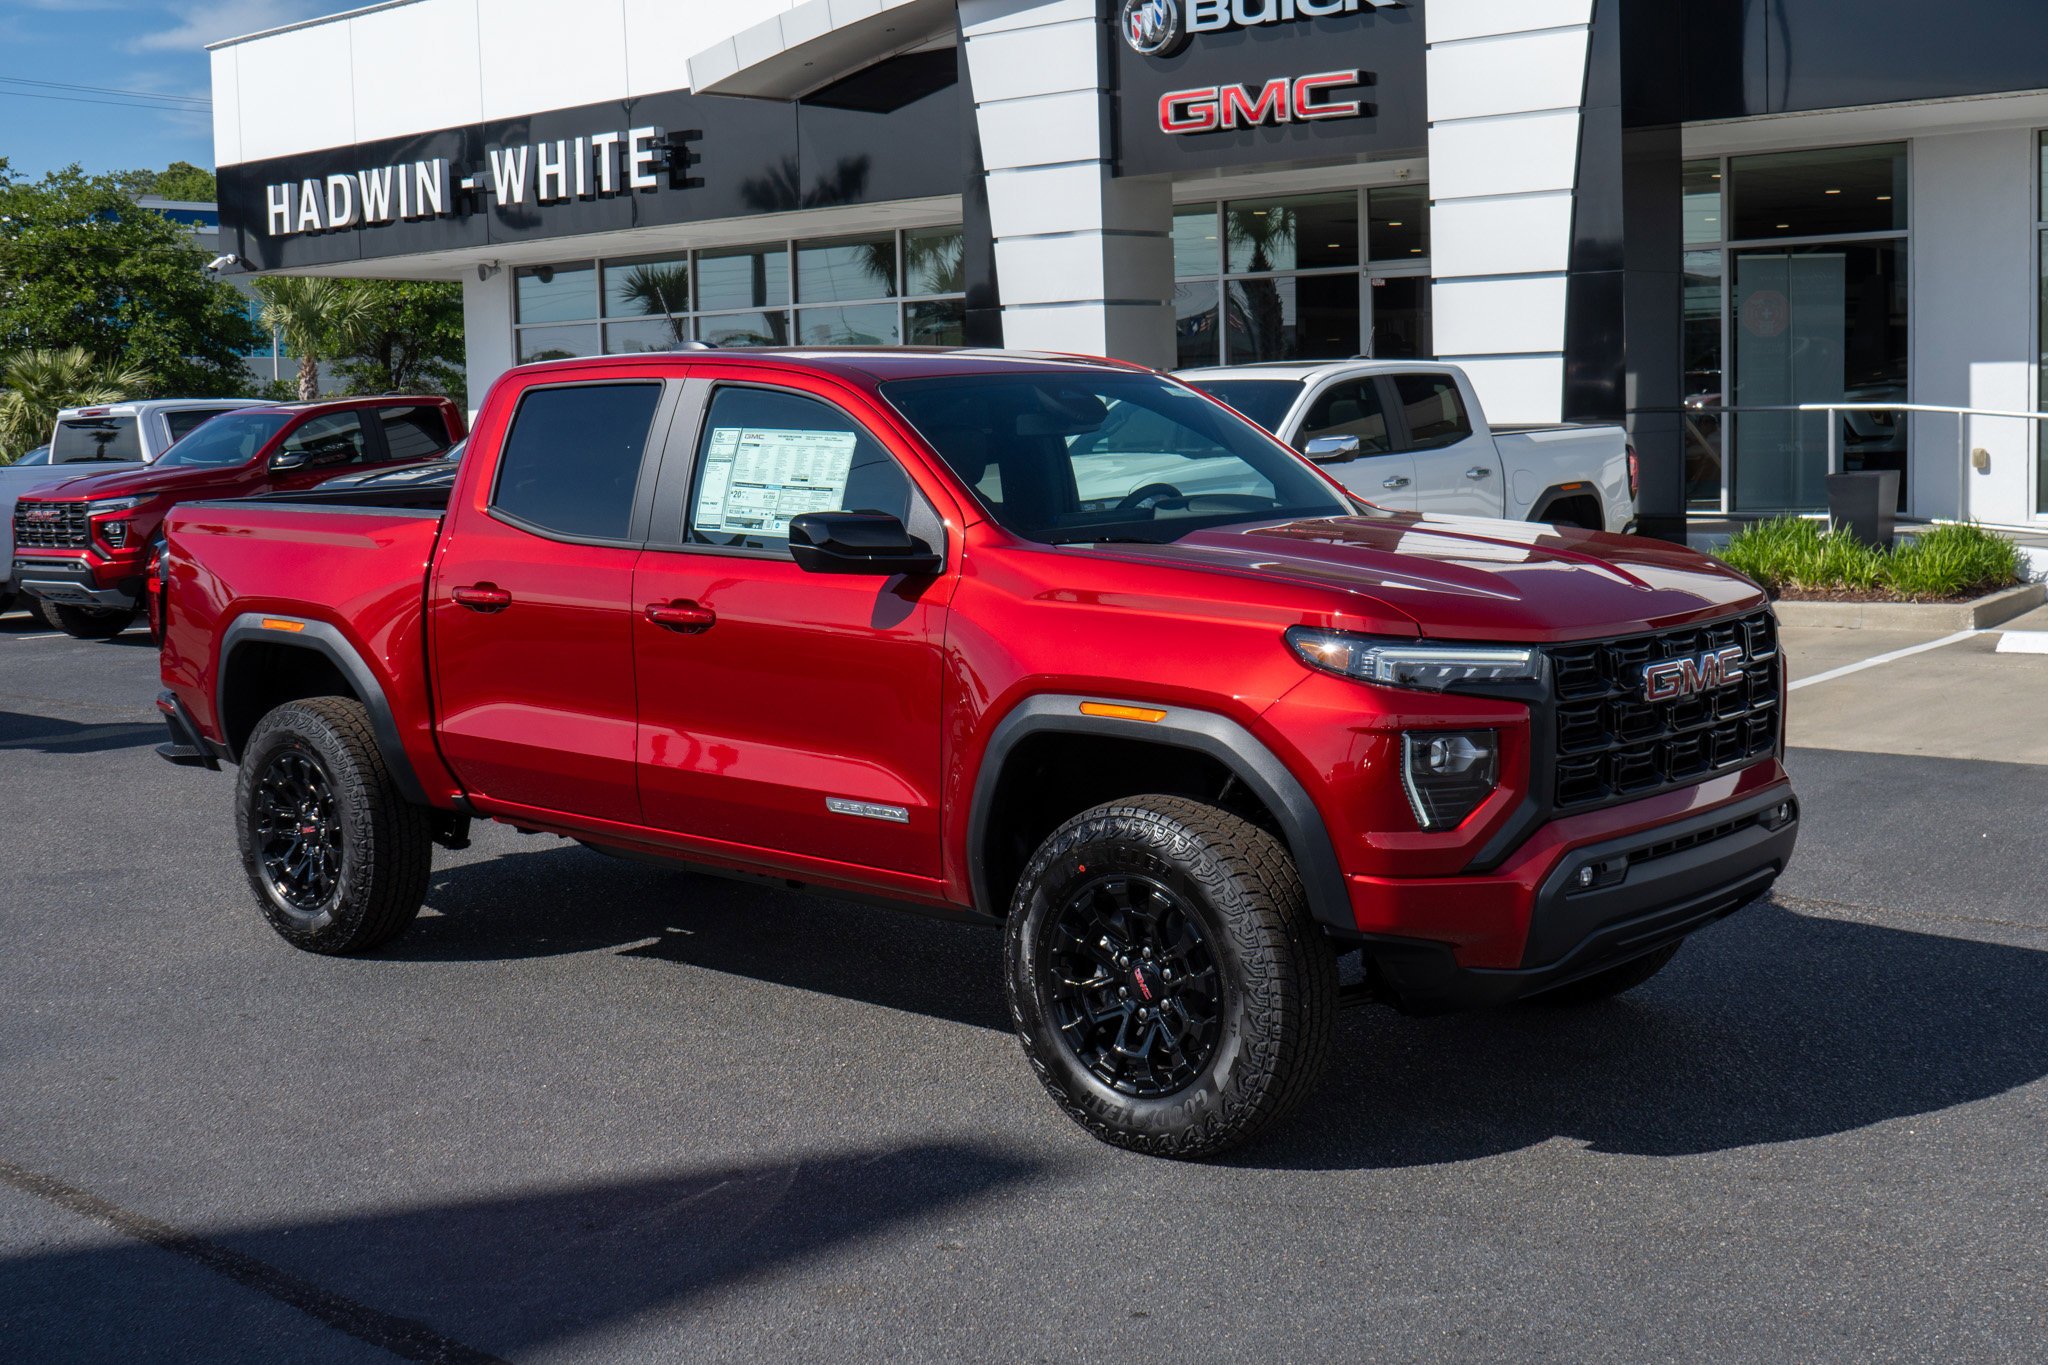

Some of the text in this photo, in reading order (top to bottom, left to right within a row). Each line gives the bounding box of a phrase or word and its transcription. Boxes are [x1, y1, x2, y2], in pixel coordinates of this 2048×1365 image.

[1186, 0, 1395, 33] BUI
[1158, 68, 1360, 134] GMC
[266, 158, 450, 236] HADWIN
[490, 126, 664, 206] WHITE
[1643, 645, 1744, 702] GMC
[832, 801, 902, 817] ELEVATION
[1134, 968, 1153, 1000] GMC
